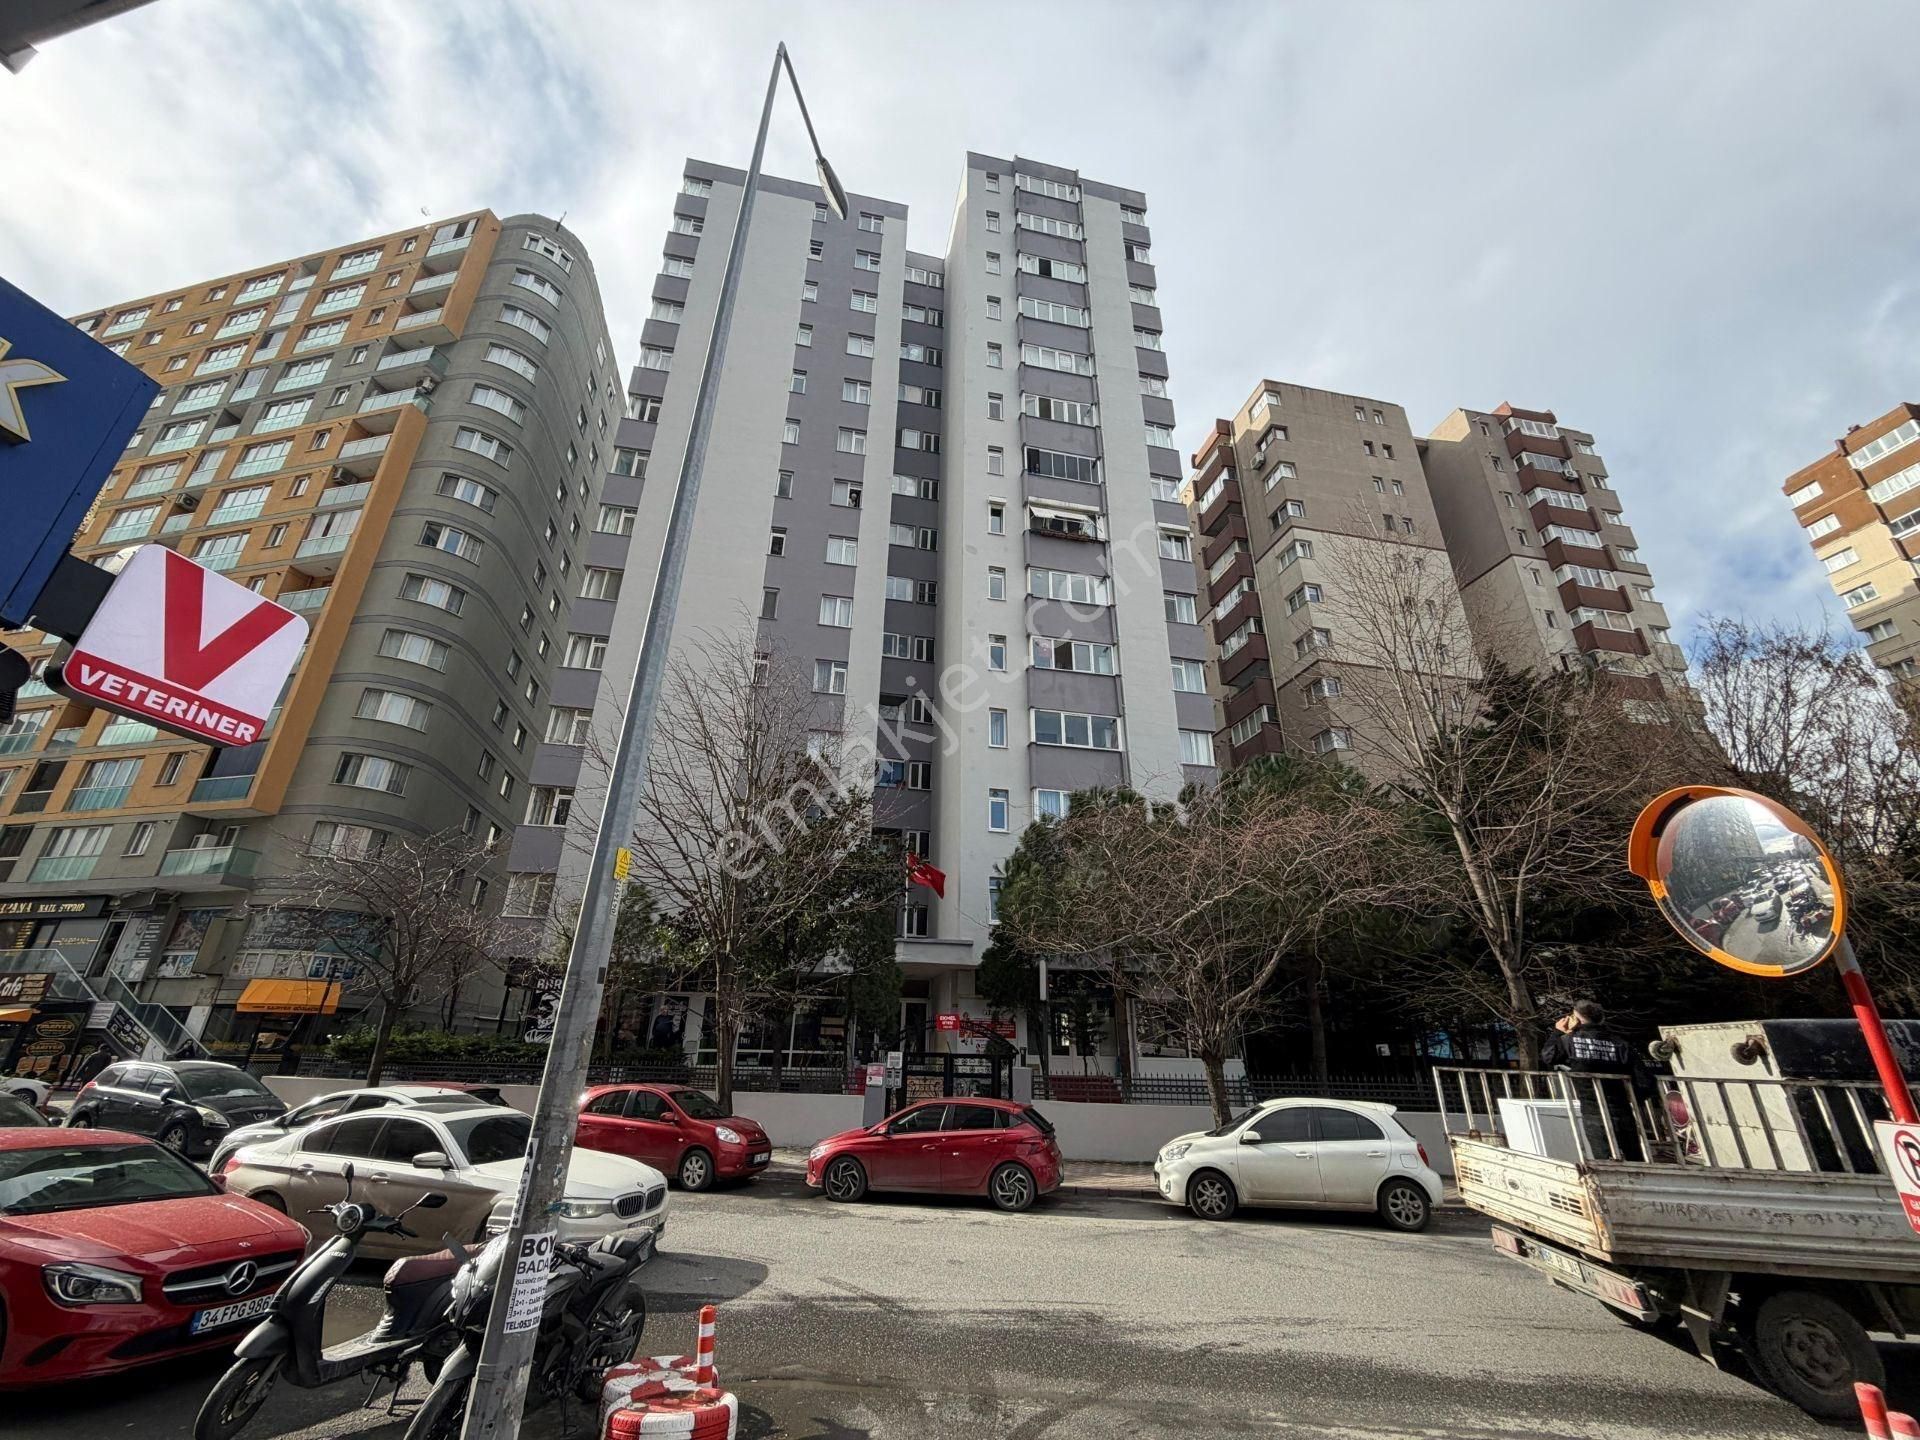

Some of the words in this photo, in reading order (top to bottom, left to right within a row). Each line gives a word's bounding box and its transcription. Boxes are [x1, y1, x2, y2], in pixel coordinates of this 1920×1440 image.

[80, 663, 256, 743] VETERİNER
[201, 1311, 219, 1328] 34
[221, 1304, 246, 1322] FPG
[247, 1297, 270, 1315] 986
